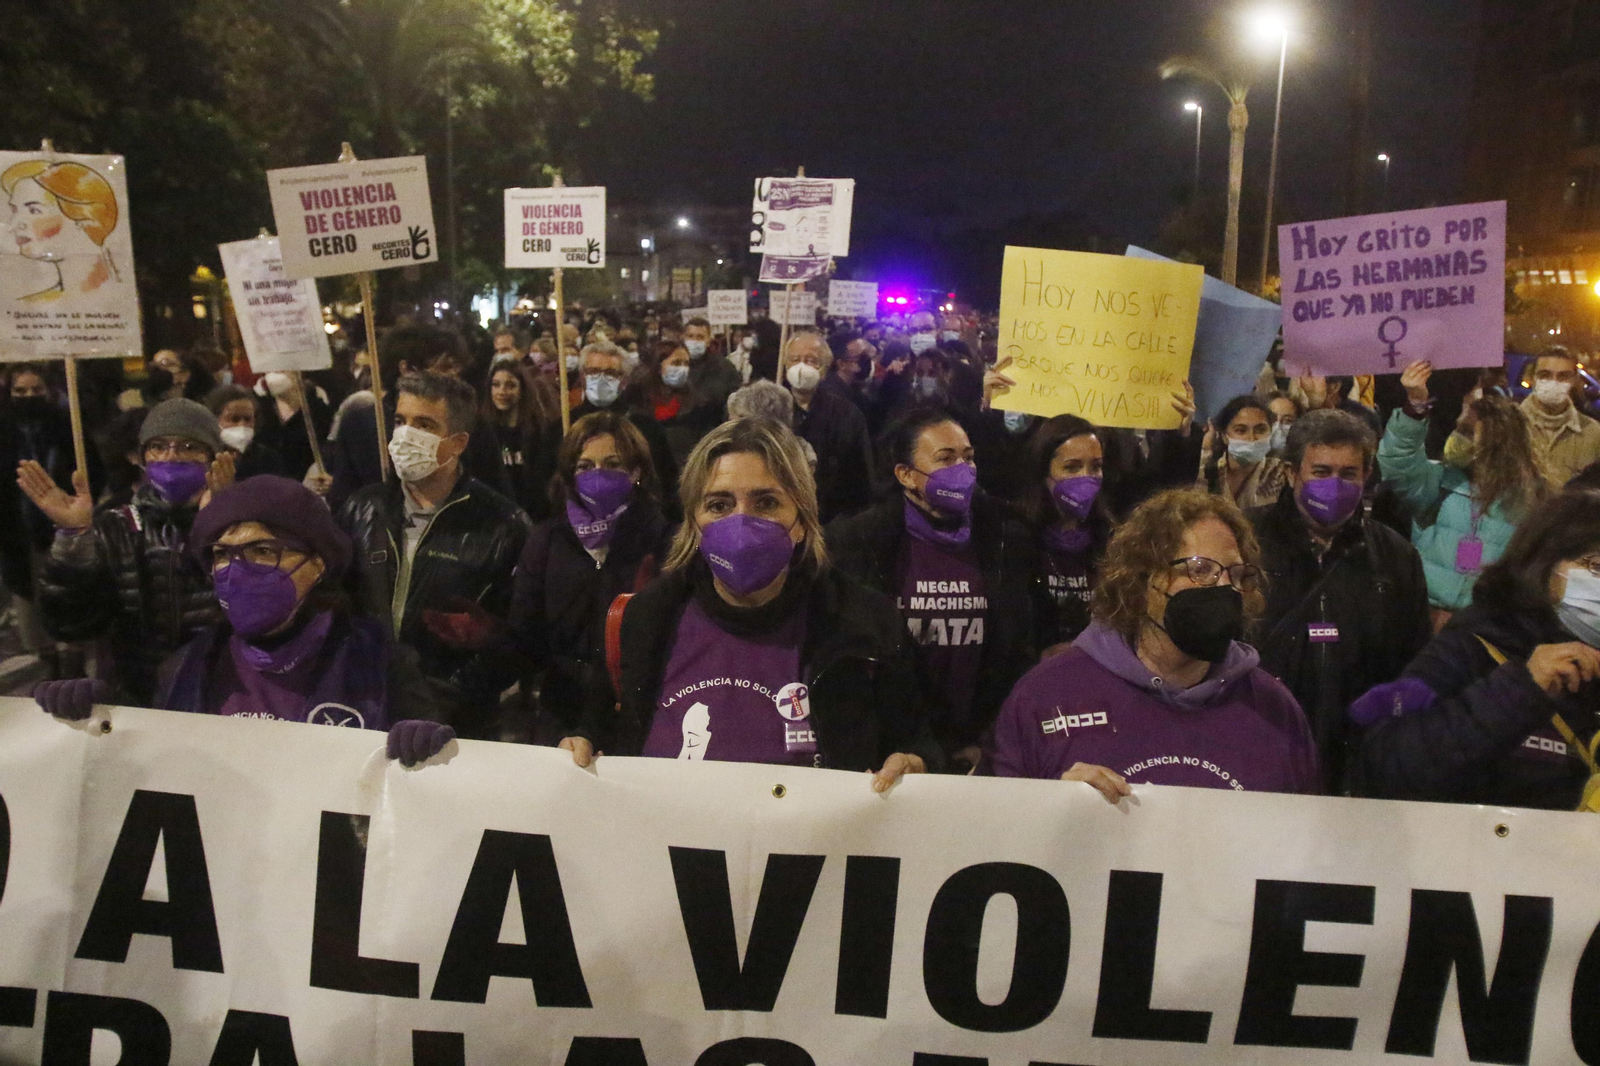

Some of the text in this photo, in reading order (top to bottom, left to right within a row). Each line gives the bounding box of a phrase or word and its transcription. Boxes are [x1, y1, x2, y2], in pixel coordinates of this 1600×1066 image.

[299, 182, 397, 211] VIOLENCIA
[304, 205, 401, 235] DE GÉNERO
[522, 204, 582, 219] VIOLENCIA
[522, 219, 584, 236] DE GÉNERO
[1291, 224, 1348, 262] HOY
[1444, 216, 1488, 244] POR
[309, 234, 357, 257] CERO
[372, 239, 410, 251] RECORTES
[381, 247, 410, 261] CERO
[522, 238, 552, 253] CERO
[566, 253, 586, 261] CERO
[1294, 249, 1488, 293] LAS HERMANAS
[1022, 259, 1075, 311] HOY
[1094, 289, 1141, 317] NOS
[1293, 285, 1475, 323] QUE YA NO PUEDEN
[1012, 318, 1177, 355] MOS EN LA CALLE
[1085, 363, 1119, 383] NOS
[578, 523, 608, 535] CCOO
[916, 580, 970, 594] NEGAR
[1309, 628, 1339, 636] CCOO
[662, 697, 677, 708] LA
[675, 677, 732, 698] VIOLENCIA
[734, 678, 750, 688] NO
[1124, 756, 1244, 792] VIOLENCIA NO SOLO SE
[74, 789, 224, 974] A
[309, 810, 593, 1009] LA
[668, 846, 1600, 1066] VIOLEN
